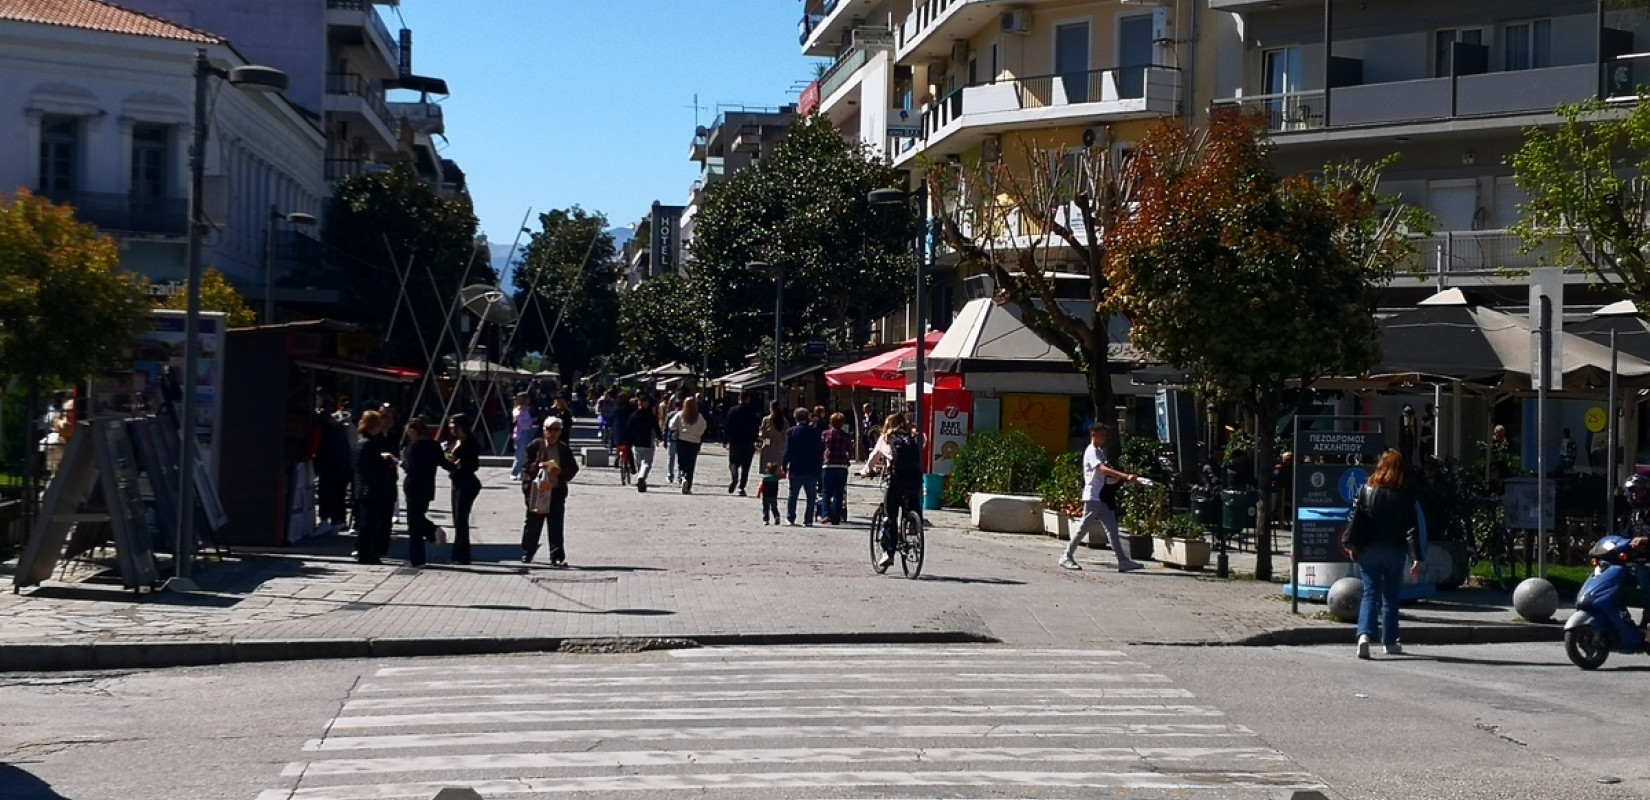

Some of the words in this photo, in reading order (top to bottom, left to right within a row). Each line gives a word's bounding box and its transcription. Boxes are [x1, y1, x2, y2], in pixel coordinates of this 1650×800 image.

[660, 216, 670, 265] HOTEL
[942, 421, 960, 429] BAKE
[940, 428, 961, 436] ROLLS
[1309, 434, 1366, 444] ΠΕΖΟΔΡΟΜΟΣ
[1313, 443, 1362, 452] ΑΣΚΛΗΠΙΟΥ
